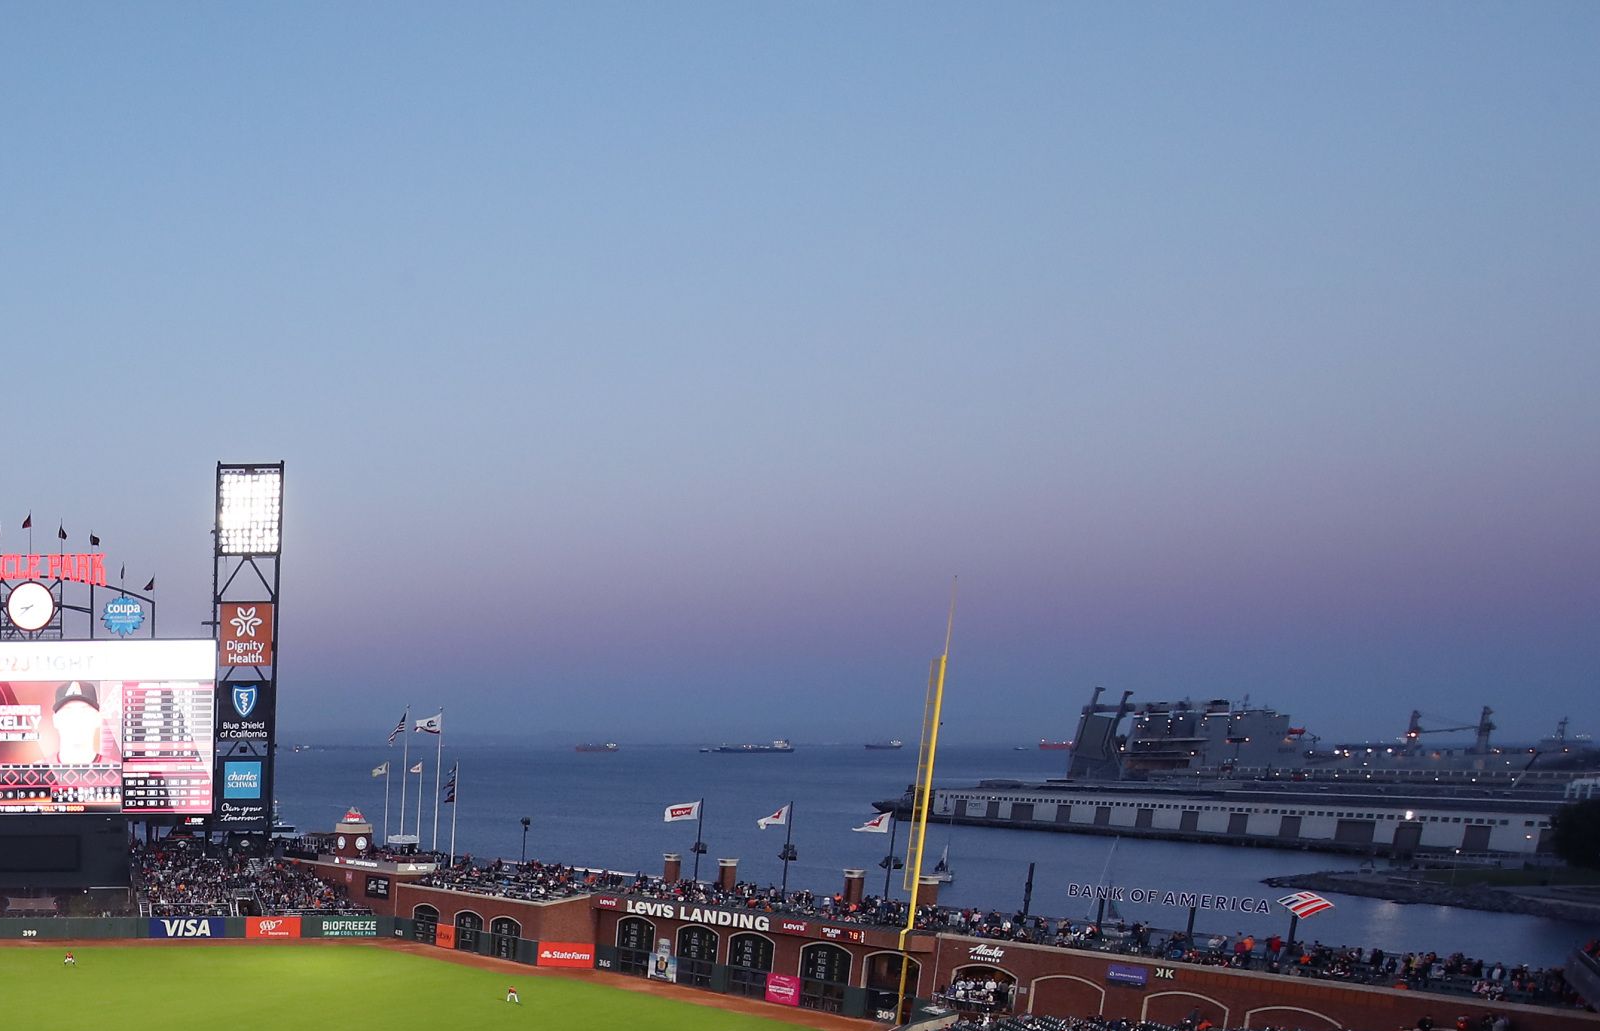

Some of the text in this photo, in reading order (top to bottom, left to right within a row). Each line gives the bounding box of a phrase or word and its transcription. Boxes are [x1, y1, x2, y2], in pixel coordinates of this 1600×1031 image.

[47, 553, 108, 588] PARK
[107, 603, 141, 614] coupa
[226, 640, 264, 652] Dignity
[223, 722, 265, 730] Blue Shield
[220, 730, 268, 738] of California
[227, 772, 257, 782] charles
[1067, 882, 1271, 914] BANK OF AMERICA
[680, 906, 770, 931] LANDING
[160, 919, 211, 937] VISA
[322, 920, 377, 931] BIOFREEZE
[552, 951, 590, 961] State Farm
[969, 944, 1005, 958] Alaska
[599, 960, 611, 968] 365
[876, 1010, 895, 1020] 309
